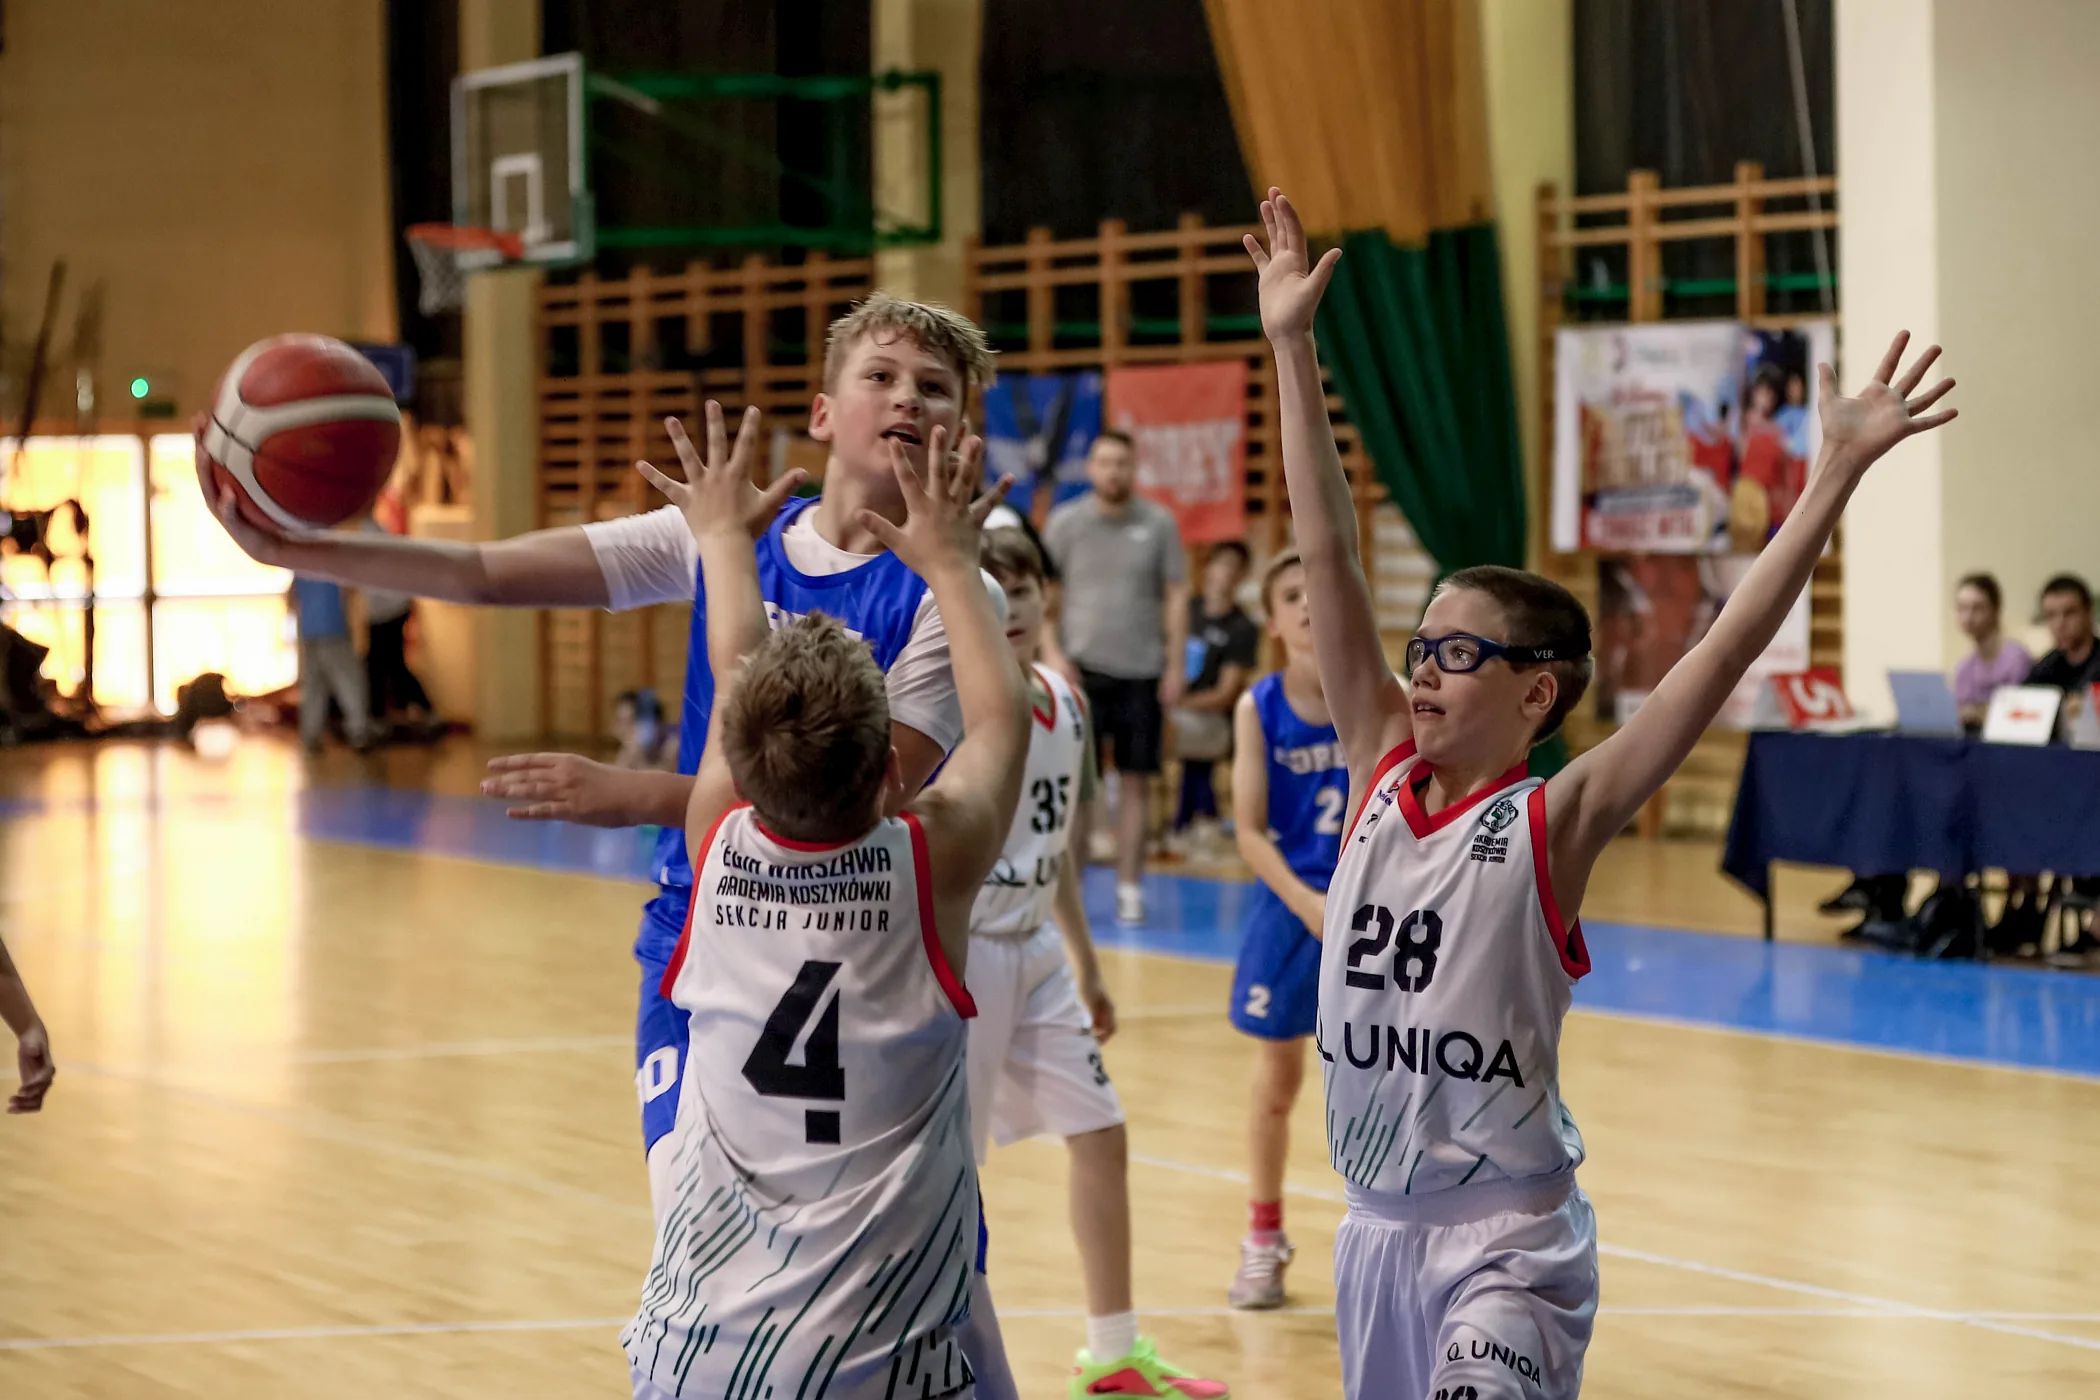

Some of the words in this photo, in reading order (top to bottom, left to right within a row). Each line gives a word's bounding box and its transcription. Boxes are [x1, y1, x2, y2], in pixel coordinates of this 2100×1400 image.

[721, 839, 762, 876] EGIA
[790, 878, 891, 905] KOSZYKÓWKI
[715, 904, 787, 931] SEKCJA
[802, 909, 890, 932] JUNIOR
[1345, 904, 1444, 994] 28
[1245, 983, 1271, 1019] 2
[740, 960, 846, 1145] 4
[1344, 1021, 1526, 1089] UNIQA
[1471, 1340, 1542, 1389] UNIQA
